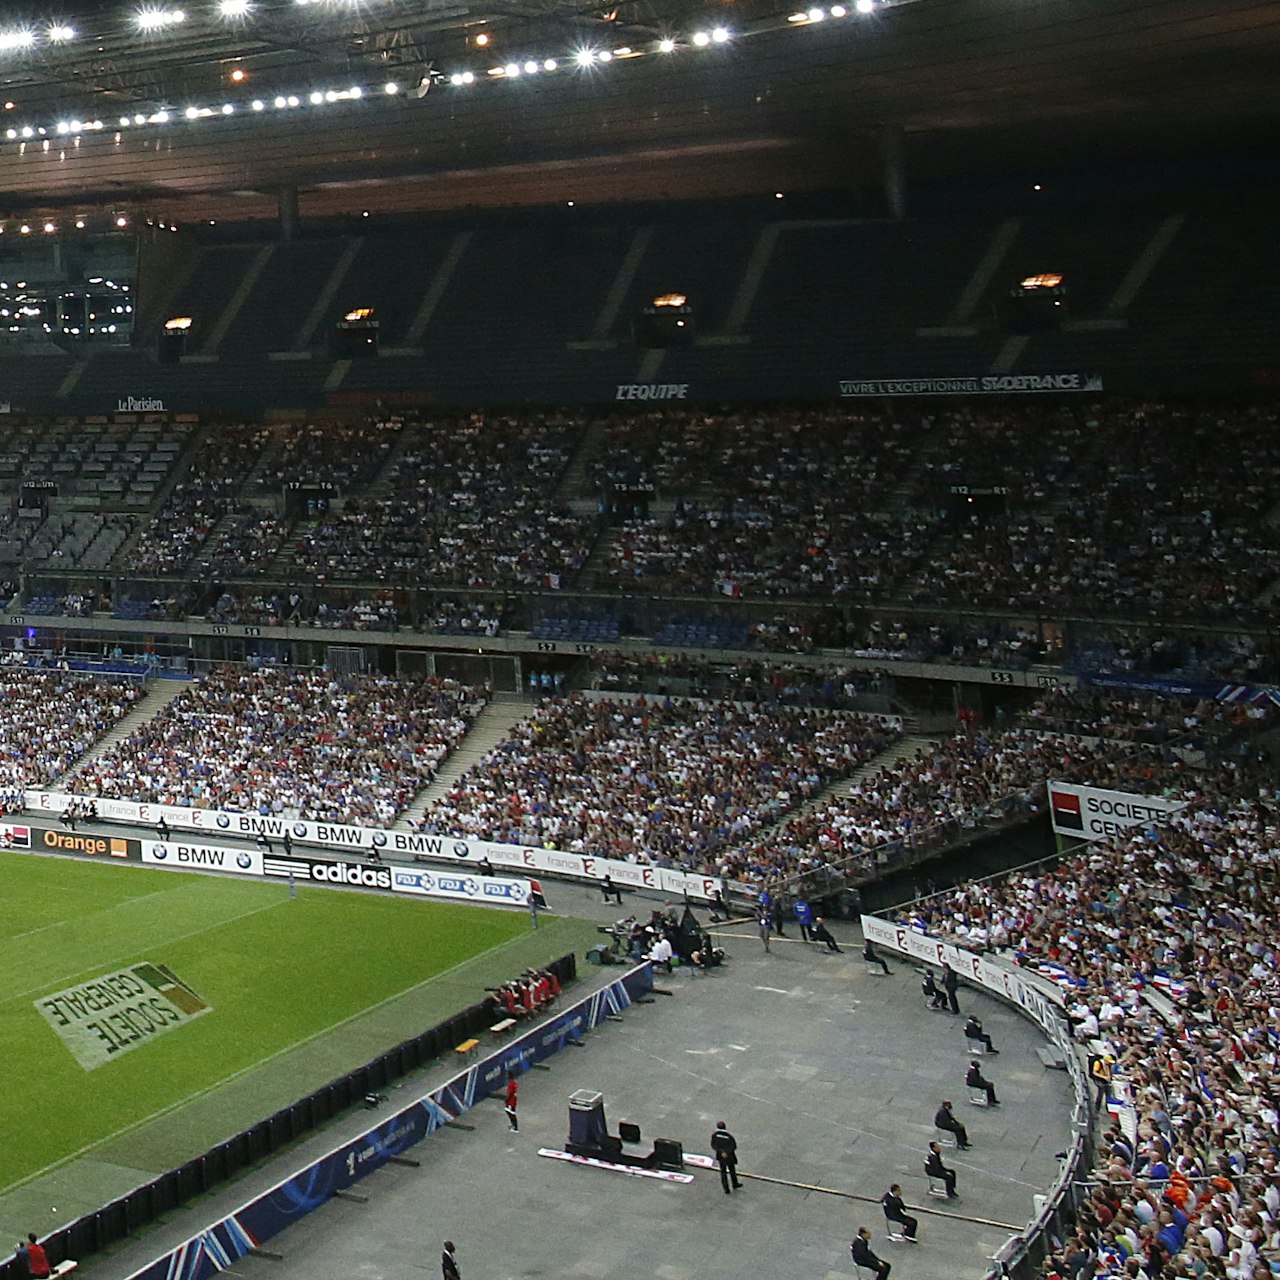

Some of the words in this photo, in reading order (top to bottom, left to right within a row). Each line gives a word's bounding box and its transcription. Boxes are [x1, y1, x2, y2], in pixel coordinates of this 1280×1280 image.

[840, 381, 875, 393] VIVRE
[879, 379, 979, 392] L'EXCEPTIONNEL
[118, 400, 127, 410] Le
[127, 396, 163, 410] Parisien
[540, 642, 553, 651] S7
[994, 672, 1010, 682] S5
[109, 804, 137, 816] france
[160, 810, 188, 821] france
[1087, 797, 1167, 824] SOCIETE
[240, 817, 283, 834] BMW
[317, 826, 362, 844] BMW
[44, 831, 106, 854] Orange
[395, 835, 443, 854] BMW
[178, 847, 225, 865] BMW
[487, 849, 520, 862] france
[547, 855, 579, 869] france
[312, 863, 390, 888] adidas
[397, 874, 418, 886] FDJ
[608, 866, 640, 880] france
[441, 879, 461, 891] FDJ
[485, 883, 506, 895] FDJ
[867, 923, 895, 942] france
[909, 936, 936, 956] france
[42, 974, 146, 1026] GENERALE
[86, 998, 180, 1054] SOCIETE
